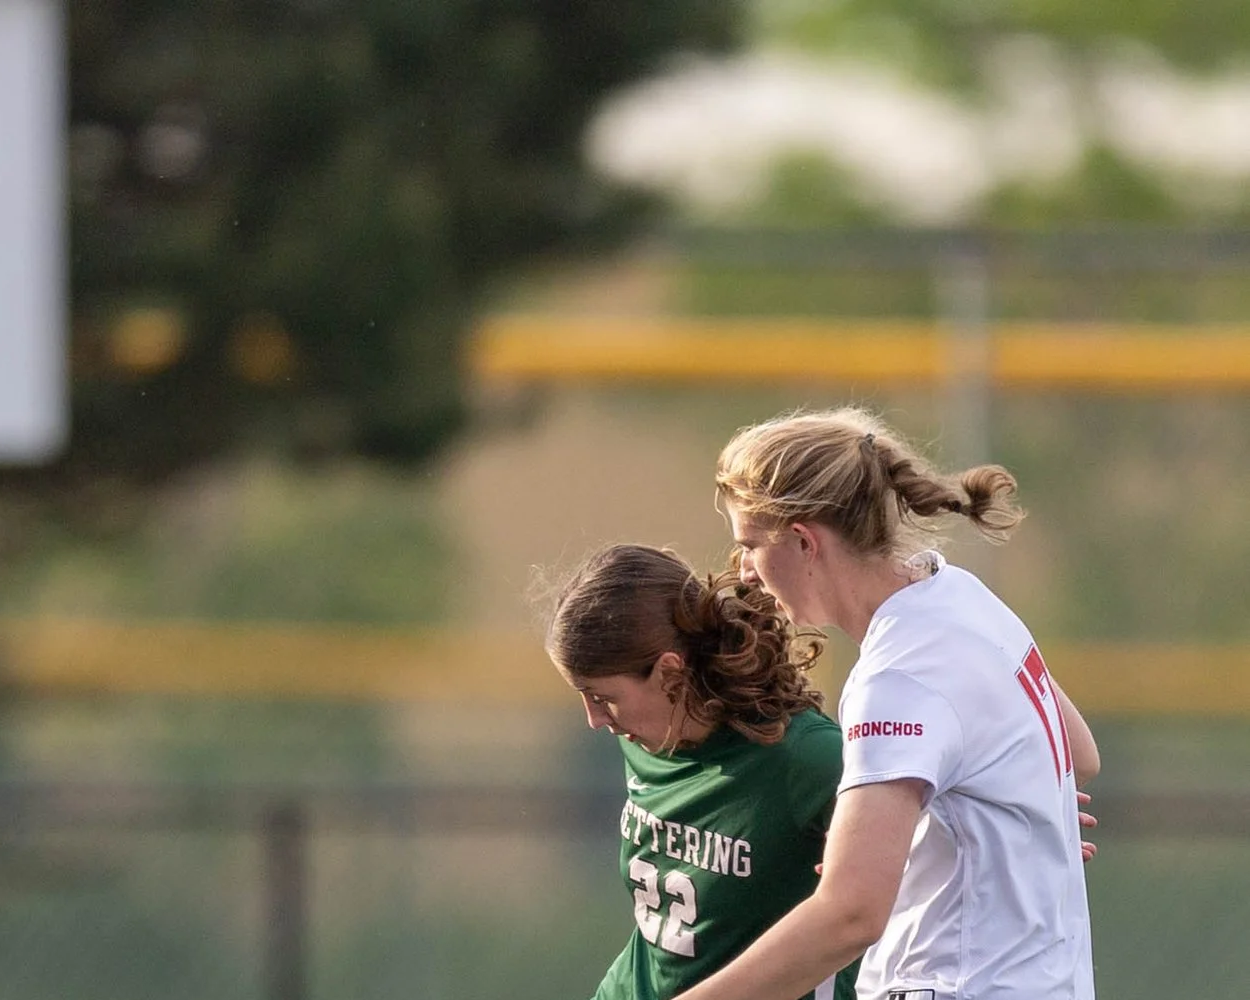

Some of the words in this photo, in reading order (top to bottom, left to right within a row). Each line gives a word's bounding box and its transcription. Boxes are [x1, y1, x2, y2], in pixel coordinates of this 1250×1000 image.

[848, 721, 923, 741] BRONCHOS
[620, 799, 752, 878] ETTERING
[628, 855, 698, 958] 22
